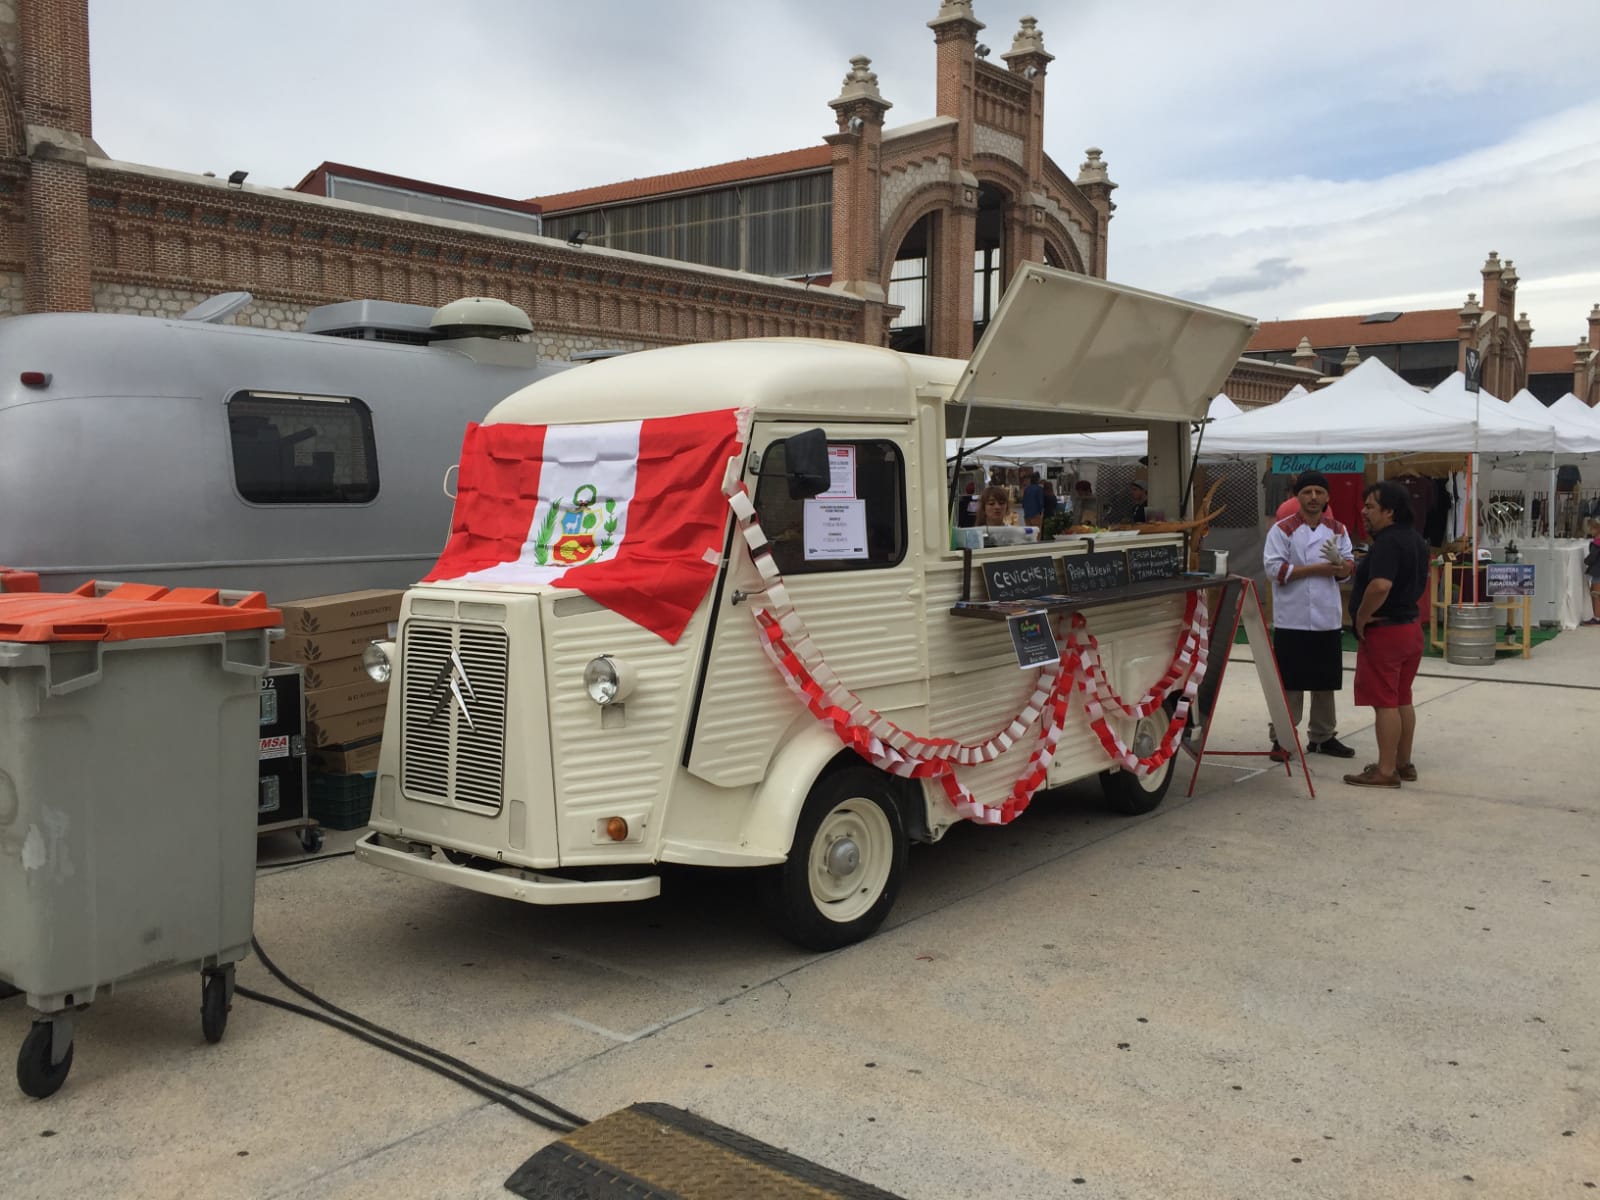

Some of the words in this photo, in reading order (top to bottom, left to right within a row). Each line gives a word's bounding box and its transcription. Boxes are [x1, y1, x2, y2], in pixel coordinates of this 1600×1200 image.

[1280, 455, 1314, 472] Blind
[1315, 455, 1357, 472] Cousins
[259, 736, 288, 750] MSA
